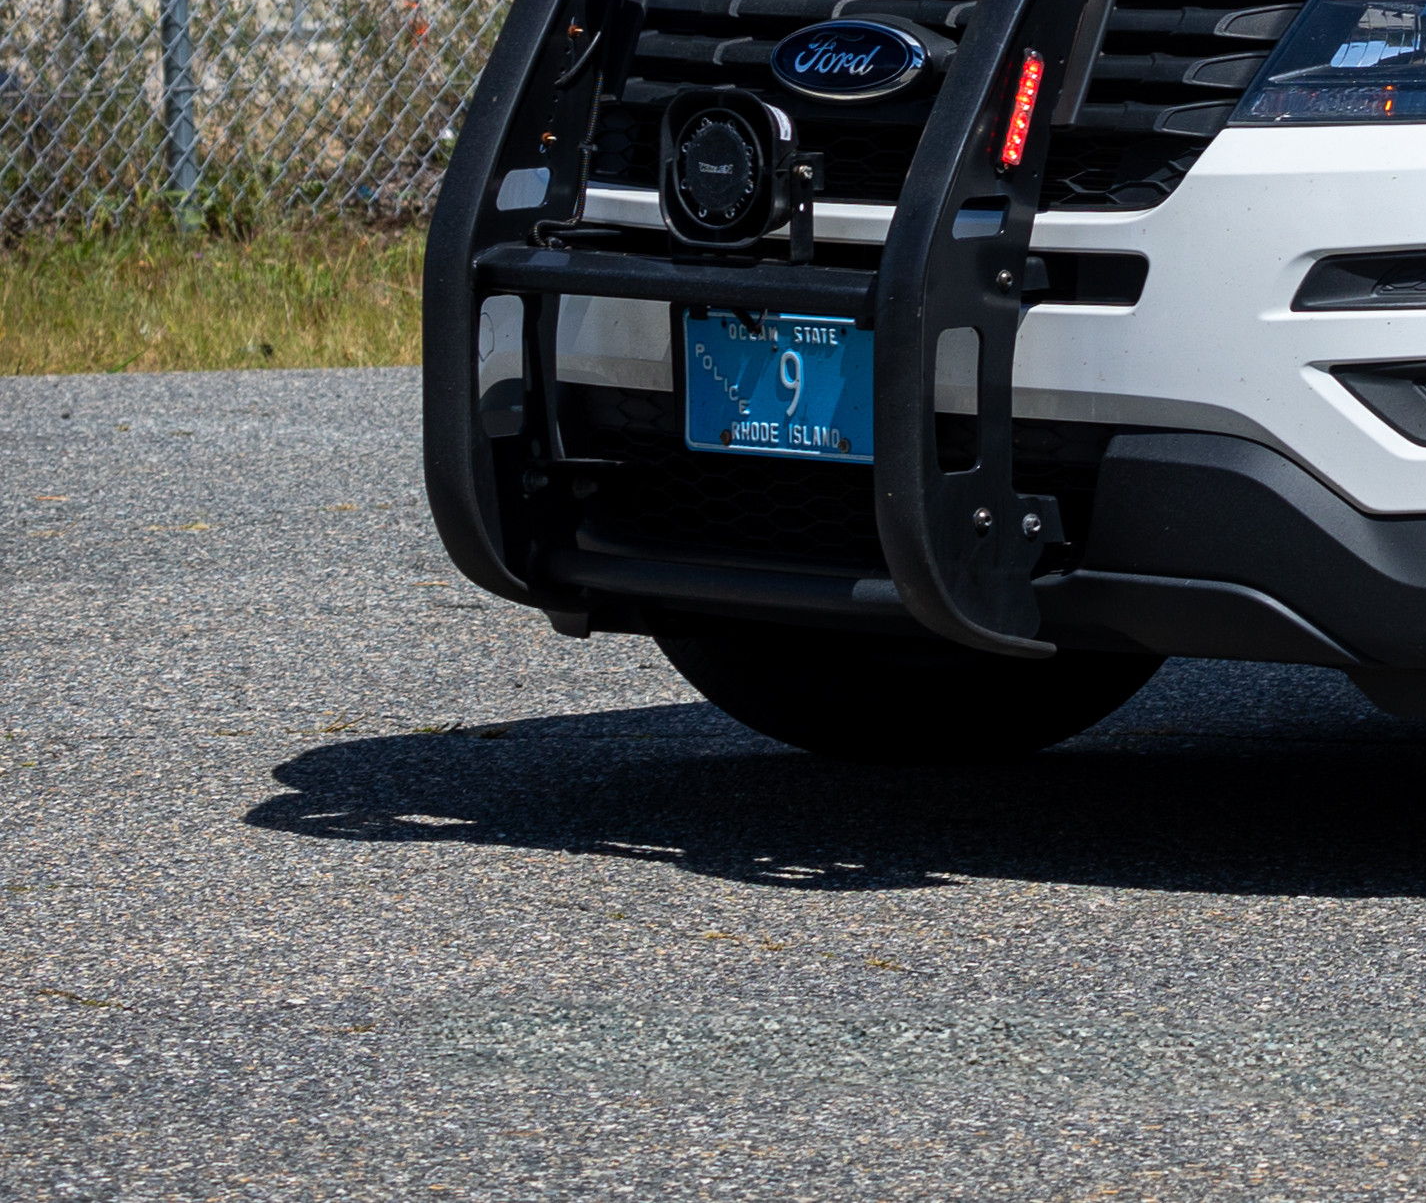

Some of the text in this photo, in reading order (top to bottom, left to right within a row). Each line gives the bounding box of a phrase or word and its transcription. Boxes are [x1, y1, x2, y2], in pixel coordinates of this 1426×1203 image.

[794, 31, 879, 76] Ford
[793, 326, 840, 345] STATE
[695, 343, 751, 415] POLICE
[779, 350, 802, 417] 9
[731, 421, 841, 449] RHODE ISLAND
